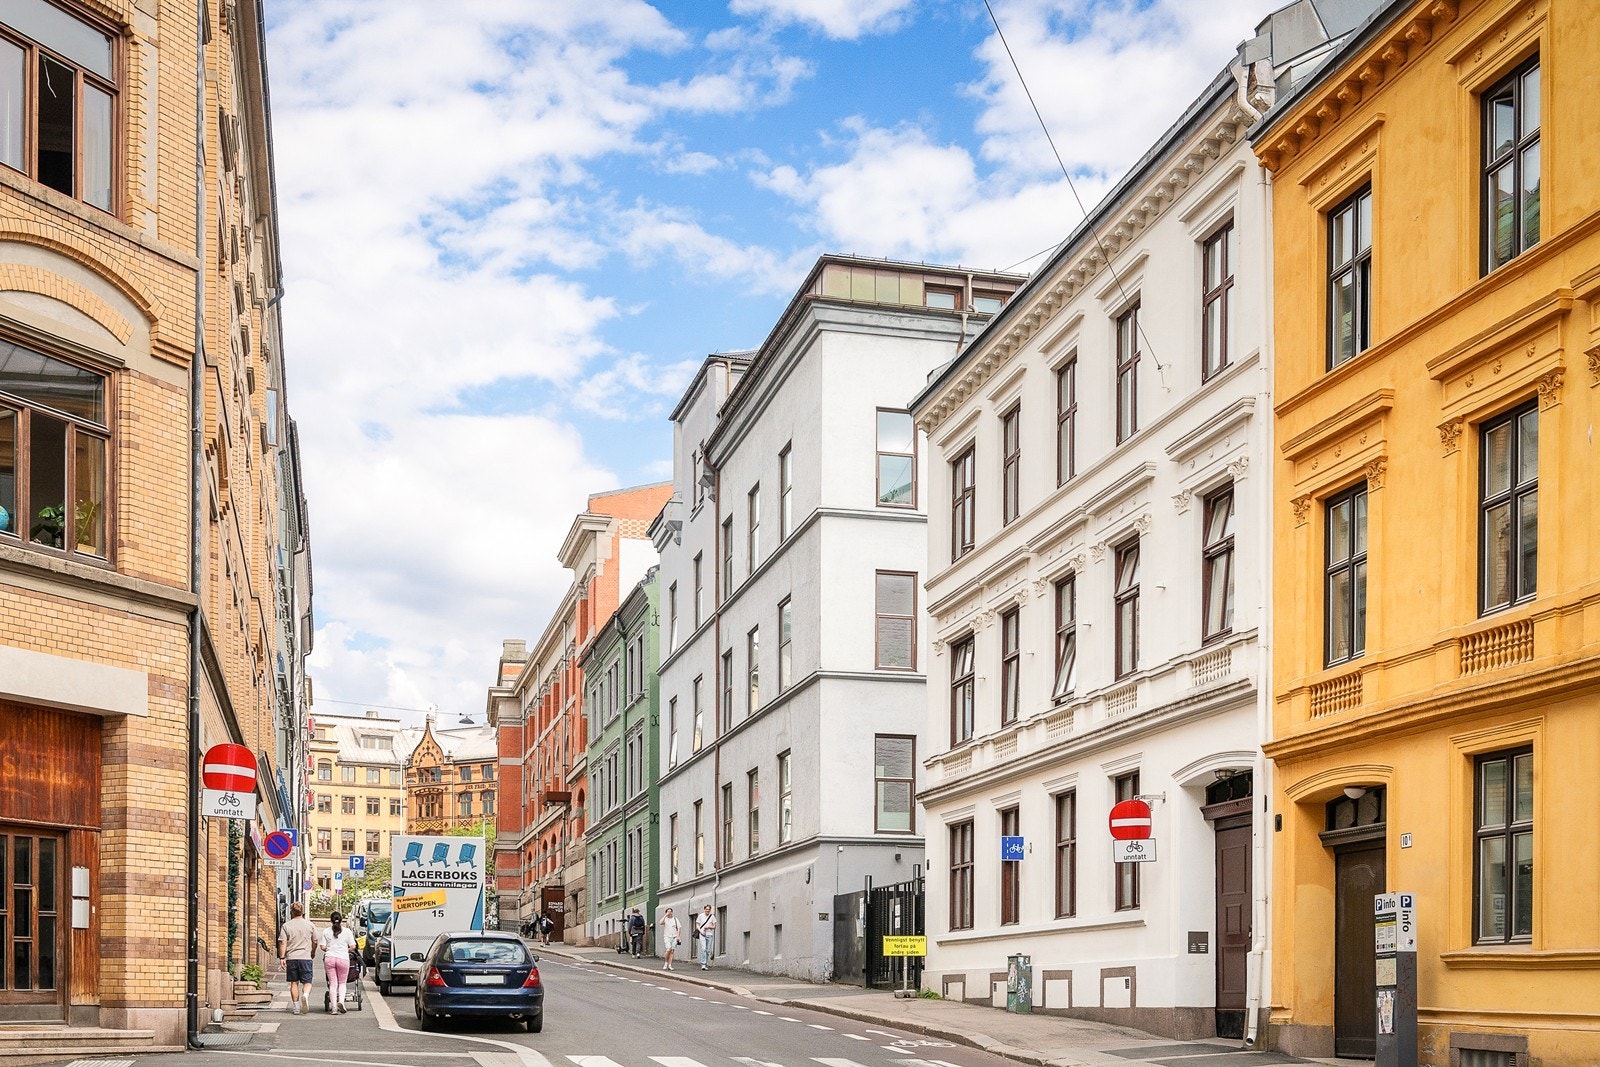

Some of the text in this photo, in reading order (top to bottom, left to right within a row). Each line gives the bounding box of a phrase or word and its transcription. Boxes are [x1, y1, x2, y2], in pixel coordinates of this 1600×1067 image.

[214, 808, 243, 816] unntatt
[352, 858, 360, 868] P
[402, 870, 477, 880] LAGERBOKS
[397, 900, 436, 910] LIERTOPPEN
[1384, 898, 1396, 909] info
[1402, 896, 1412, 932] P info
